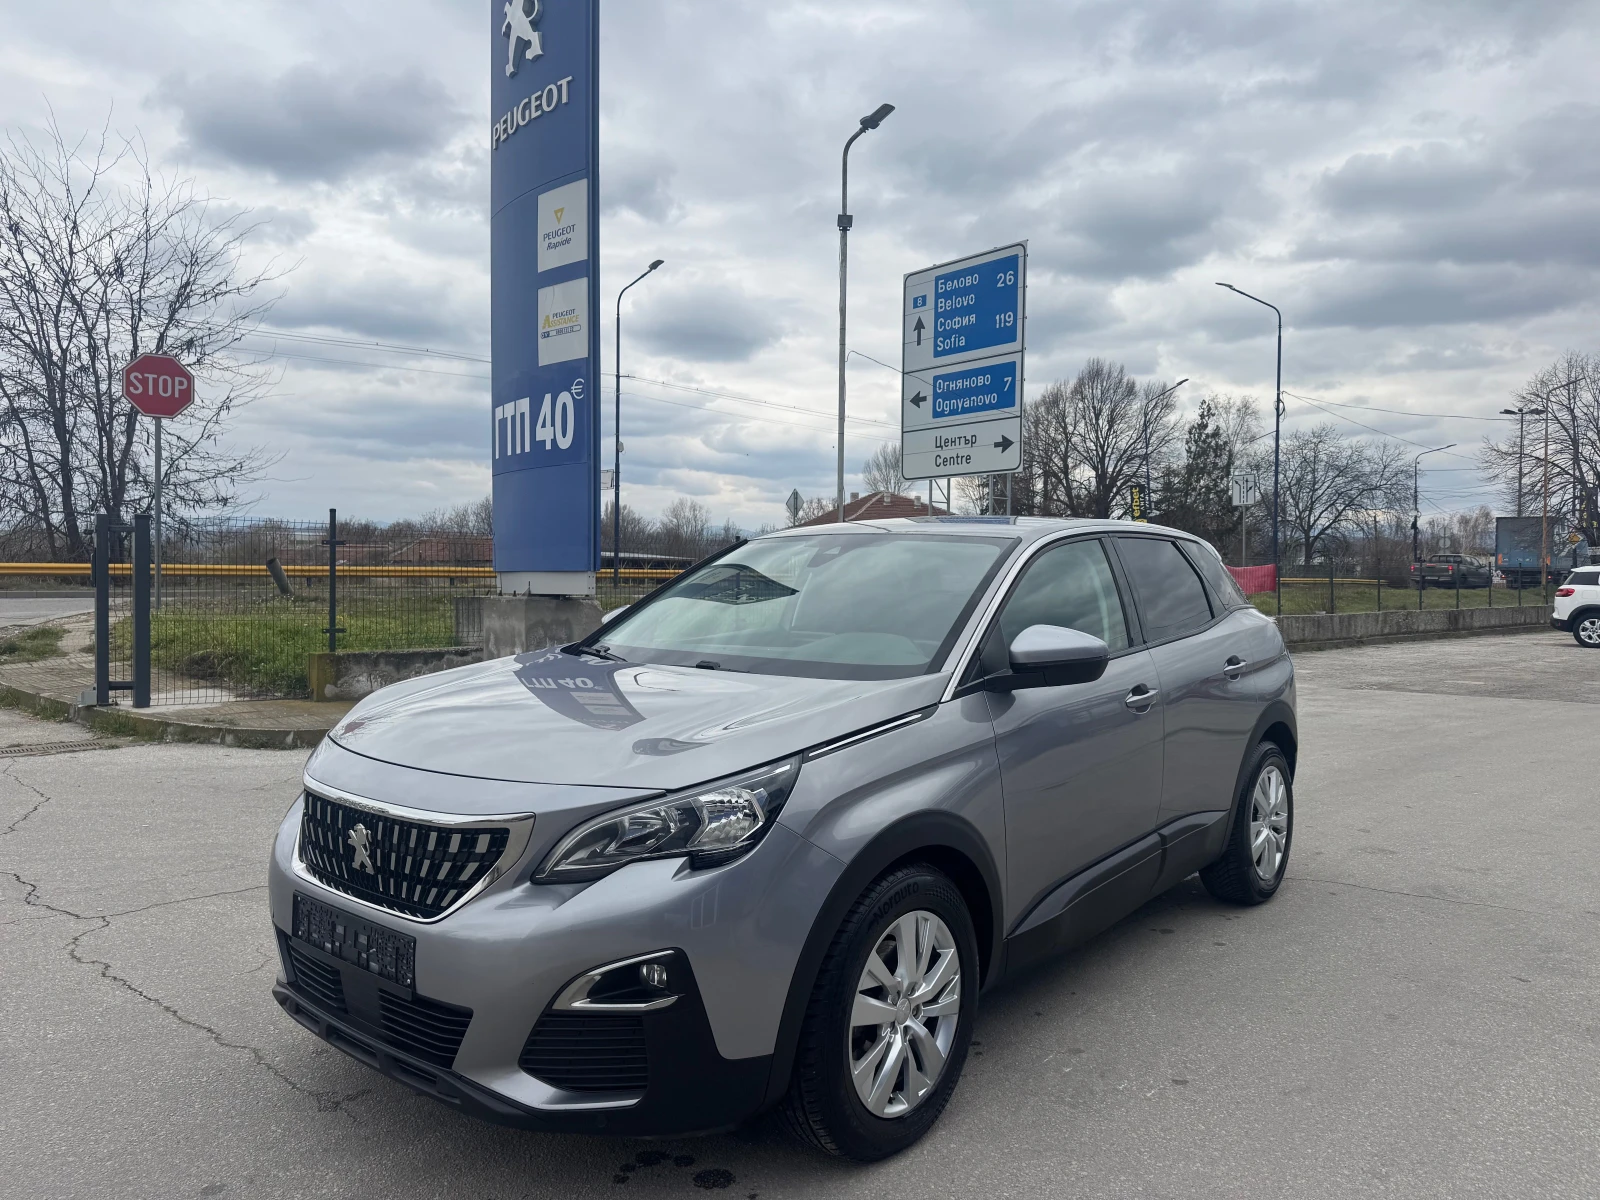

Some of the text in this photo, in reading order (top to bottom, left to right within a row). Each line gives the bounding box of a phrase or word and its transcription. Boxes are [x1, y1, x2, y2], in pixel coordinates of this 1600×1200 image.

[492, 75, 574, 151] PEUGEOT
[543, 224, 576, 241] PEUGEOT
[546, 236, 572, 251] Rapide
[938, 270, 1015, 293] Белово 26
[916, 297, 923, 307] 8
[938, 293, 975, 313] Belovo
[552, 308, 576, 319] PEUGEOT
[937, 312, 1014, 332] София 119
[937, 333, 966, 351] Sofia
[129, 371, 188, 399] STOP
[936, 374, 1012, 393] Огняново 7
[935, 391, 998, 414] Ognyanovo
[495, 396, 531, 460] ГТП
[934, 433, 977, 450] Център
[934, 452, 972, 468] Centre
[1132, 486, 1140, 517] efbet
[873, 881, 919, 920] Norauto
